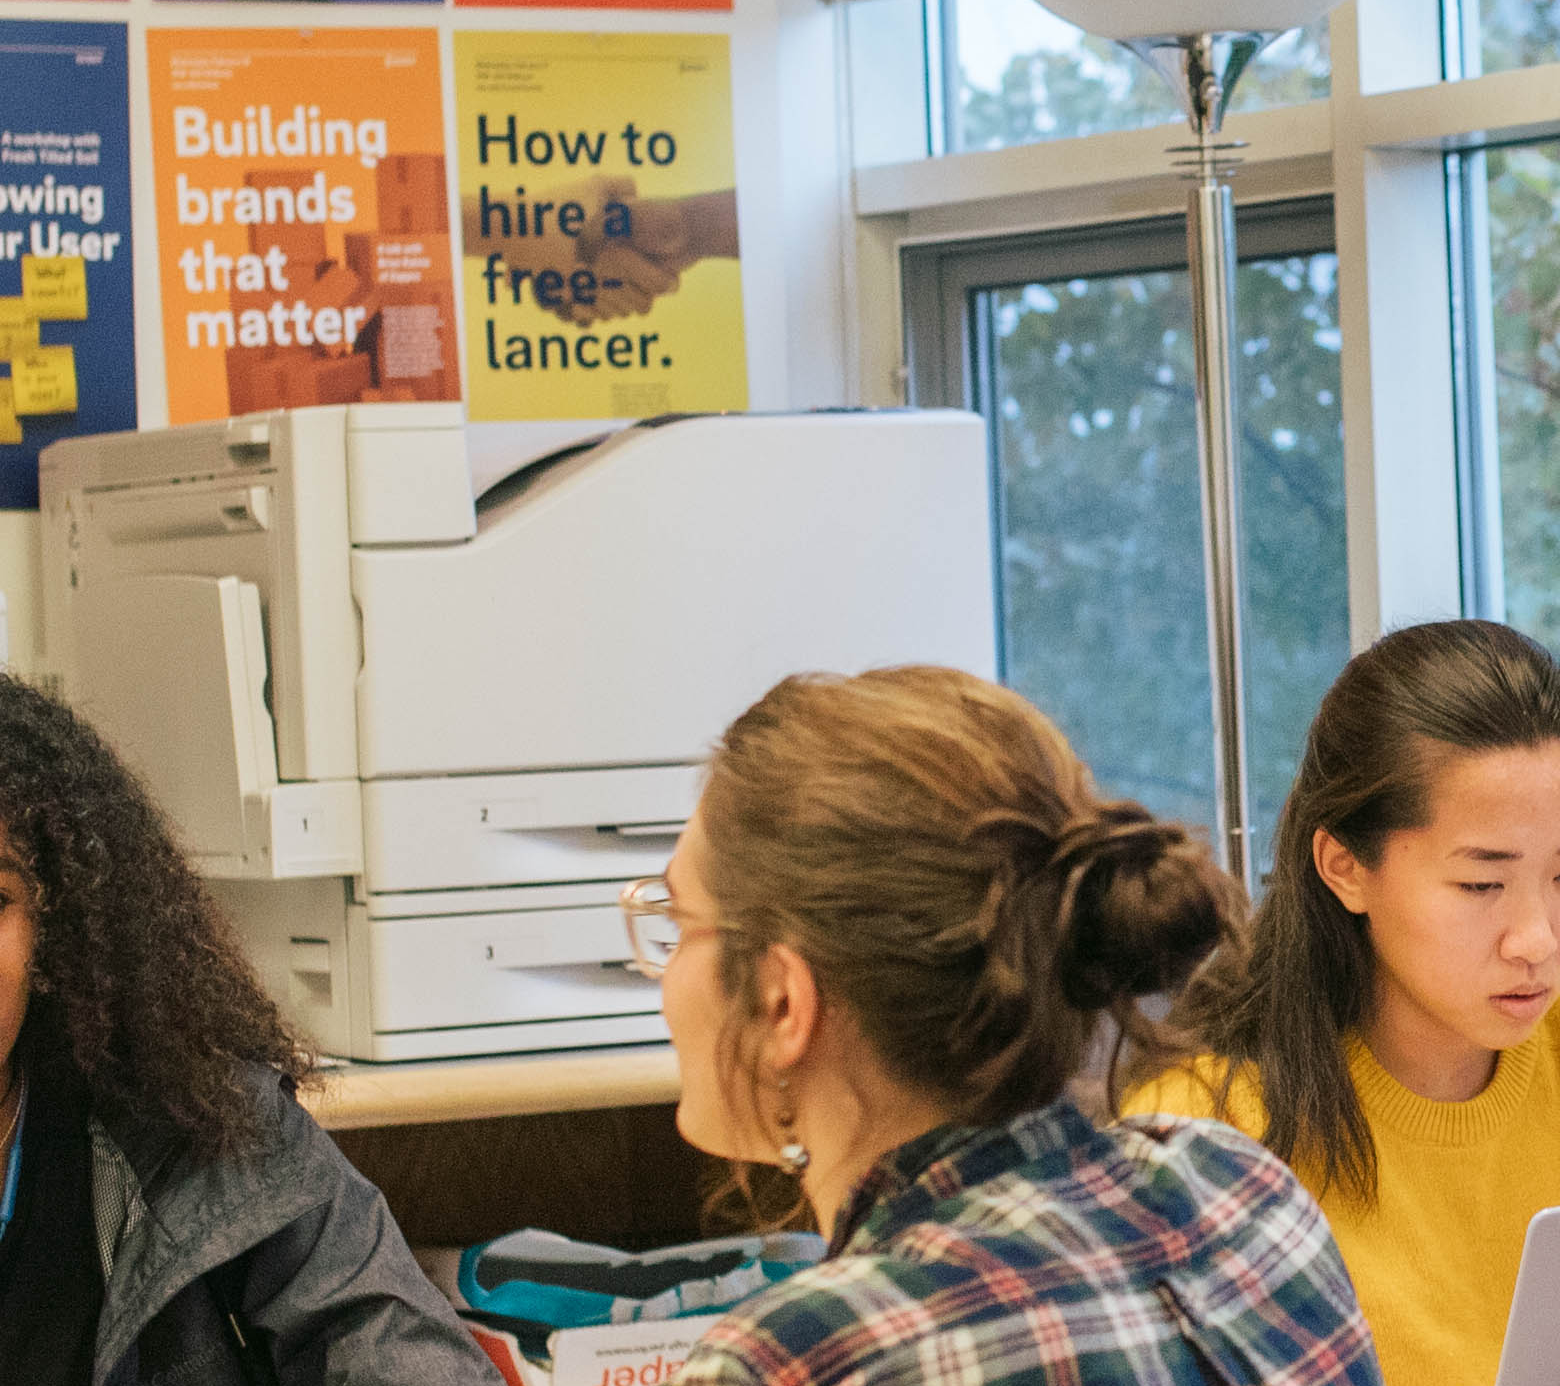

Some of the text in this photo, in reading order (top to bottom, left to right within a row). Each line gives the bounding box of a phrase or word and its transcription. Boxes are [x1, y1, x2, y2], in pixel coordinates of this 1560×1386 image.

[1, 131, 102, 149] A workshop with
[173, 105, 388, 169] Building
[477, 114, 678, 167] How to
[176, 172, 357, 225] brands
[479, 186, 634, 240] hire a
[32, 226, 121, 263] User
[180, 242, 289, 294] that
[483, 253, 624, 308] free-
[187, 301, 366, 349] matter
[487, 318, 673, 370] lancer.
[300, 816, 310, 834] 1
[478, 806, 489, 824] 2
[484, 944, 495, 962] 3
